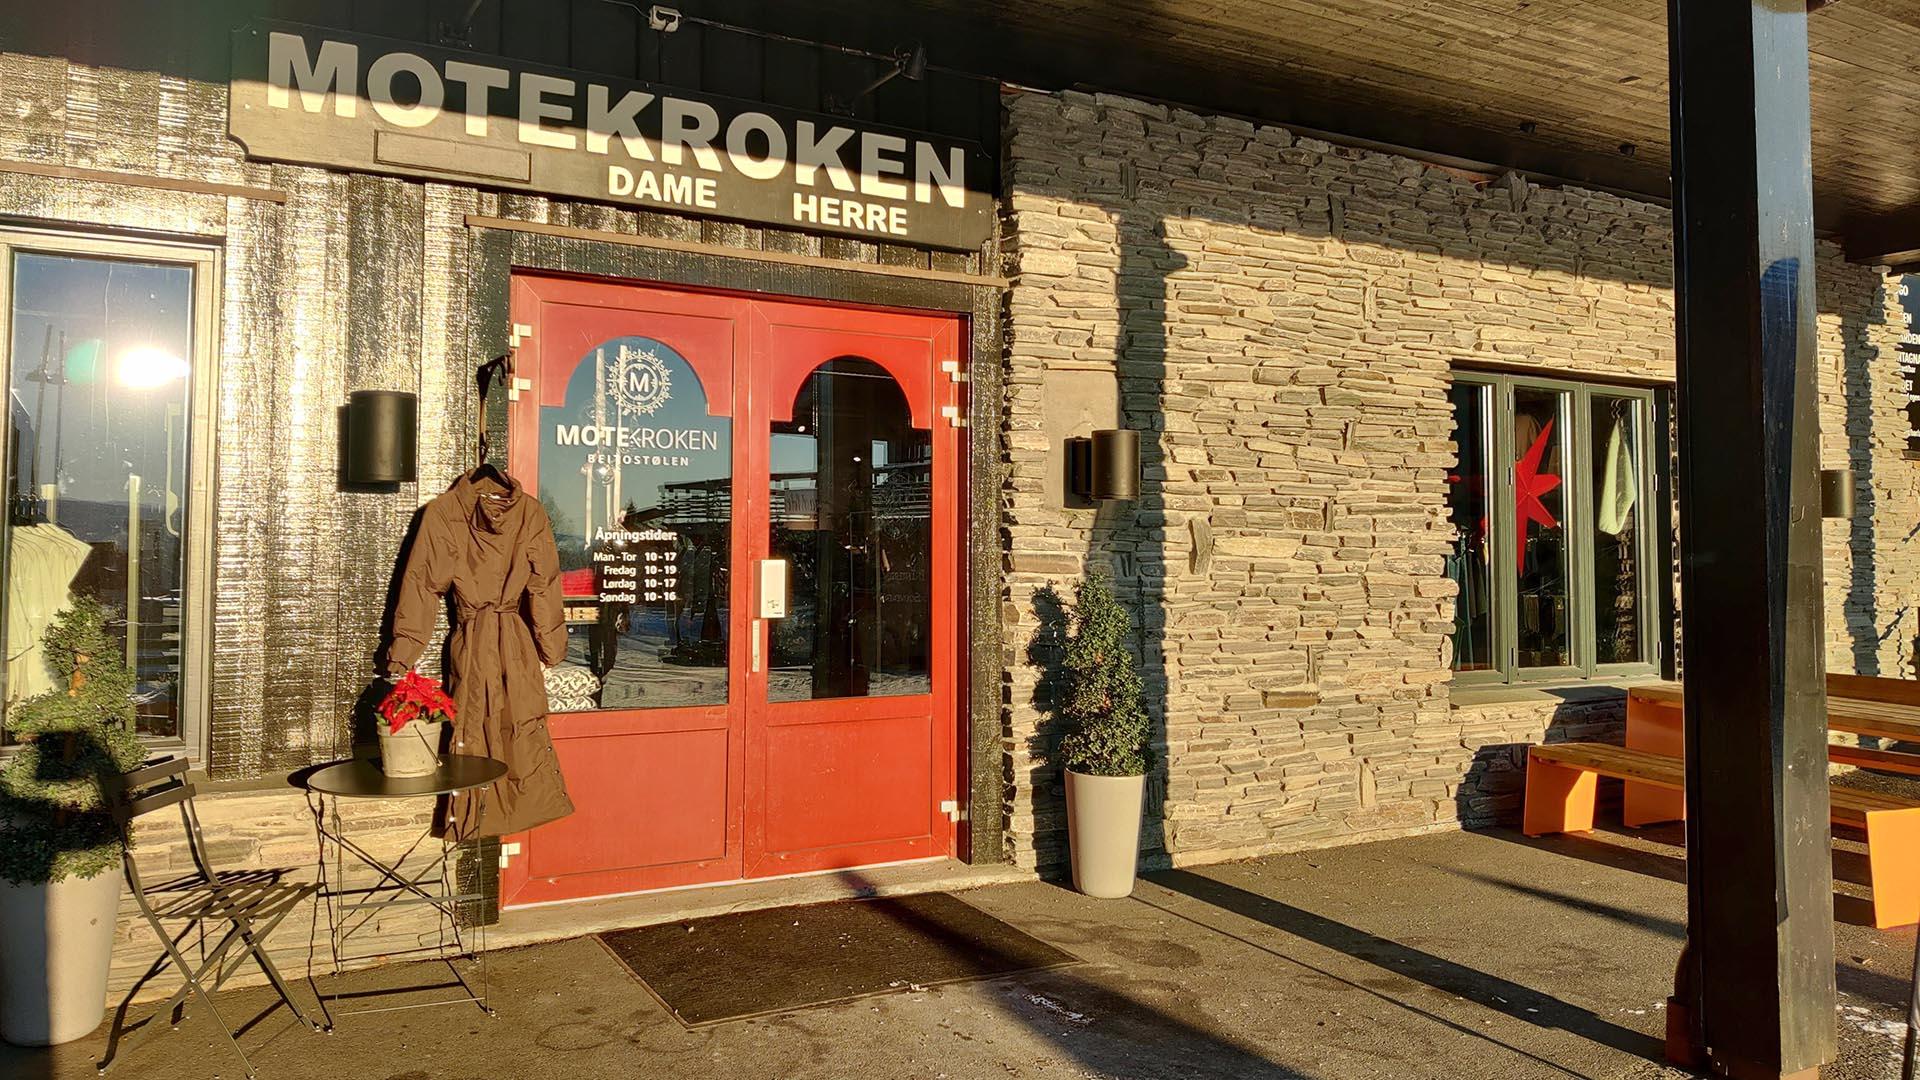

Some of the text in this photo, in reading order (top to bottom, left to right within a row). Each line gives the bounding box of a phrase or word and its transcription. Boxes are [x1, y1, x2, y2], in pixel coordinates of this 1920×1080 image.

[268, 32, 967, 209] MOTEKROKEN
[608, 165, 908, 236] DAME HERRE
[629, 372, 649, 393] M
[556, 424, 718, 451] MOTEKROKEN
[587, 453, 690, 467] BEITOSTØLEN
[595, 526, 678, 543] Åpningstider:
[593, 552, 615, 562] Man
[621, 552, 637, 562] Tor
[603, 565, 637, 577] Fredag
[603, 578, 637, 591] Lørdag
[599, 592, 637, 604] Søndag
